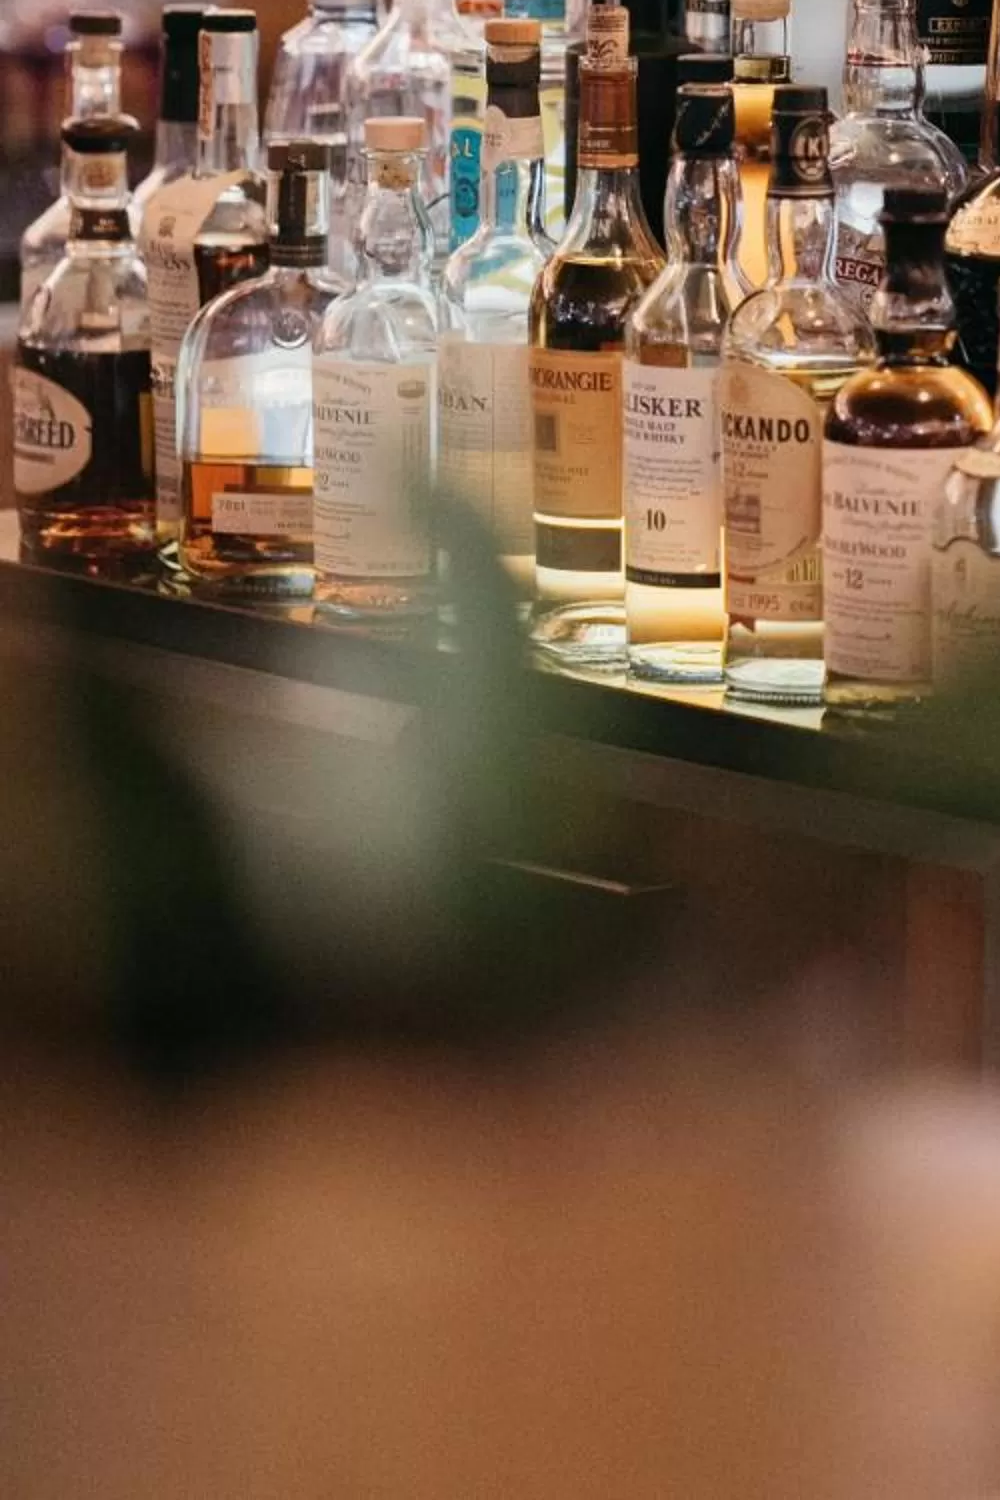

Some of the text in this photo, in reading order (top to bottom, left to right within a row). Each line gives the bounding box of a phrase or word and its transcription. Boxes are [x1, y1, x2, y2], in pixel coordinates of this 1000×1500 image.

[836, 260, 881, 285] REGA
[646, 507, 667, 531] 10
[844, 567, 864, 590] 12
